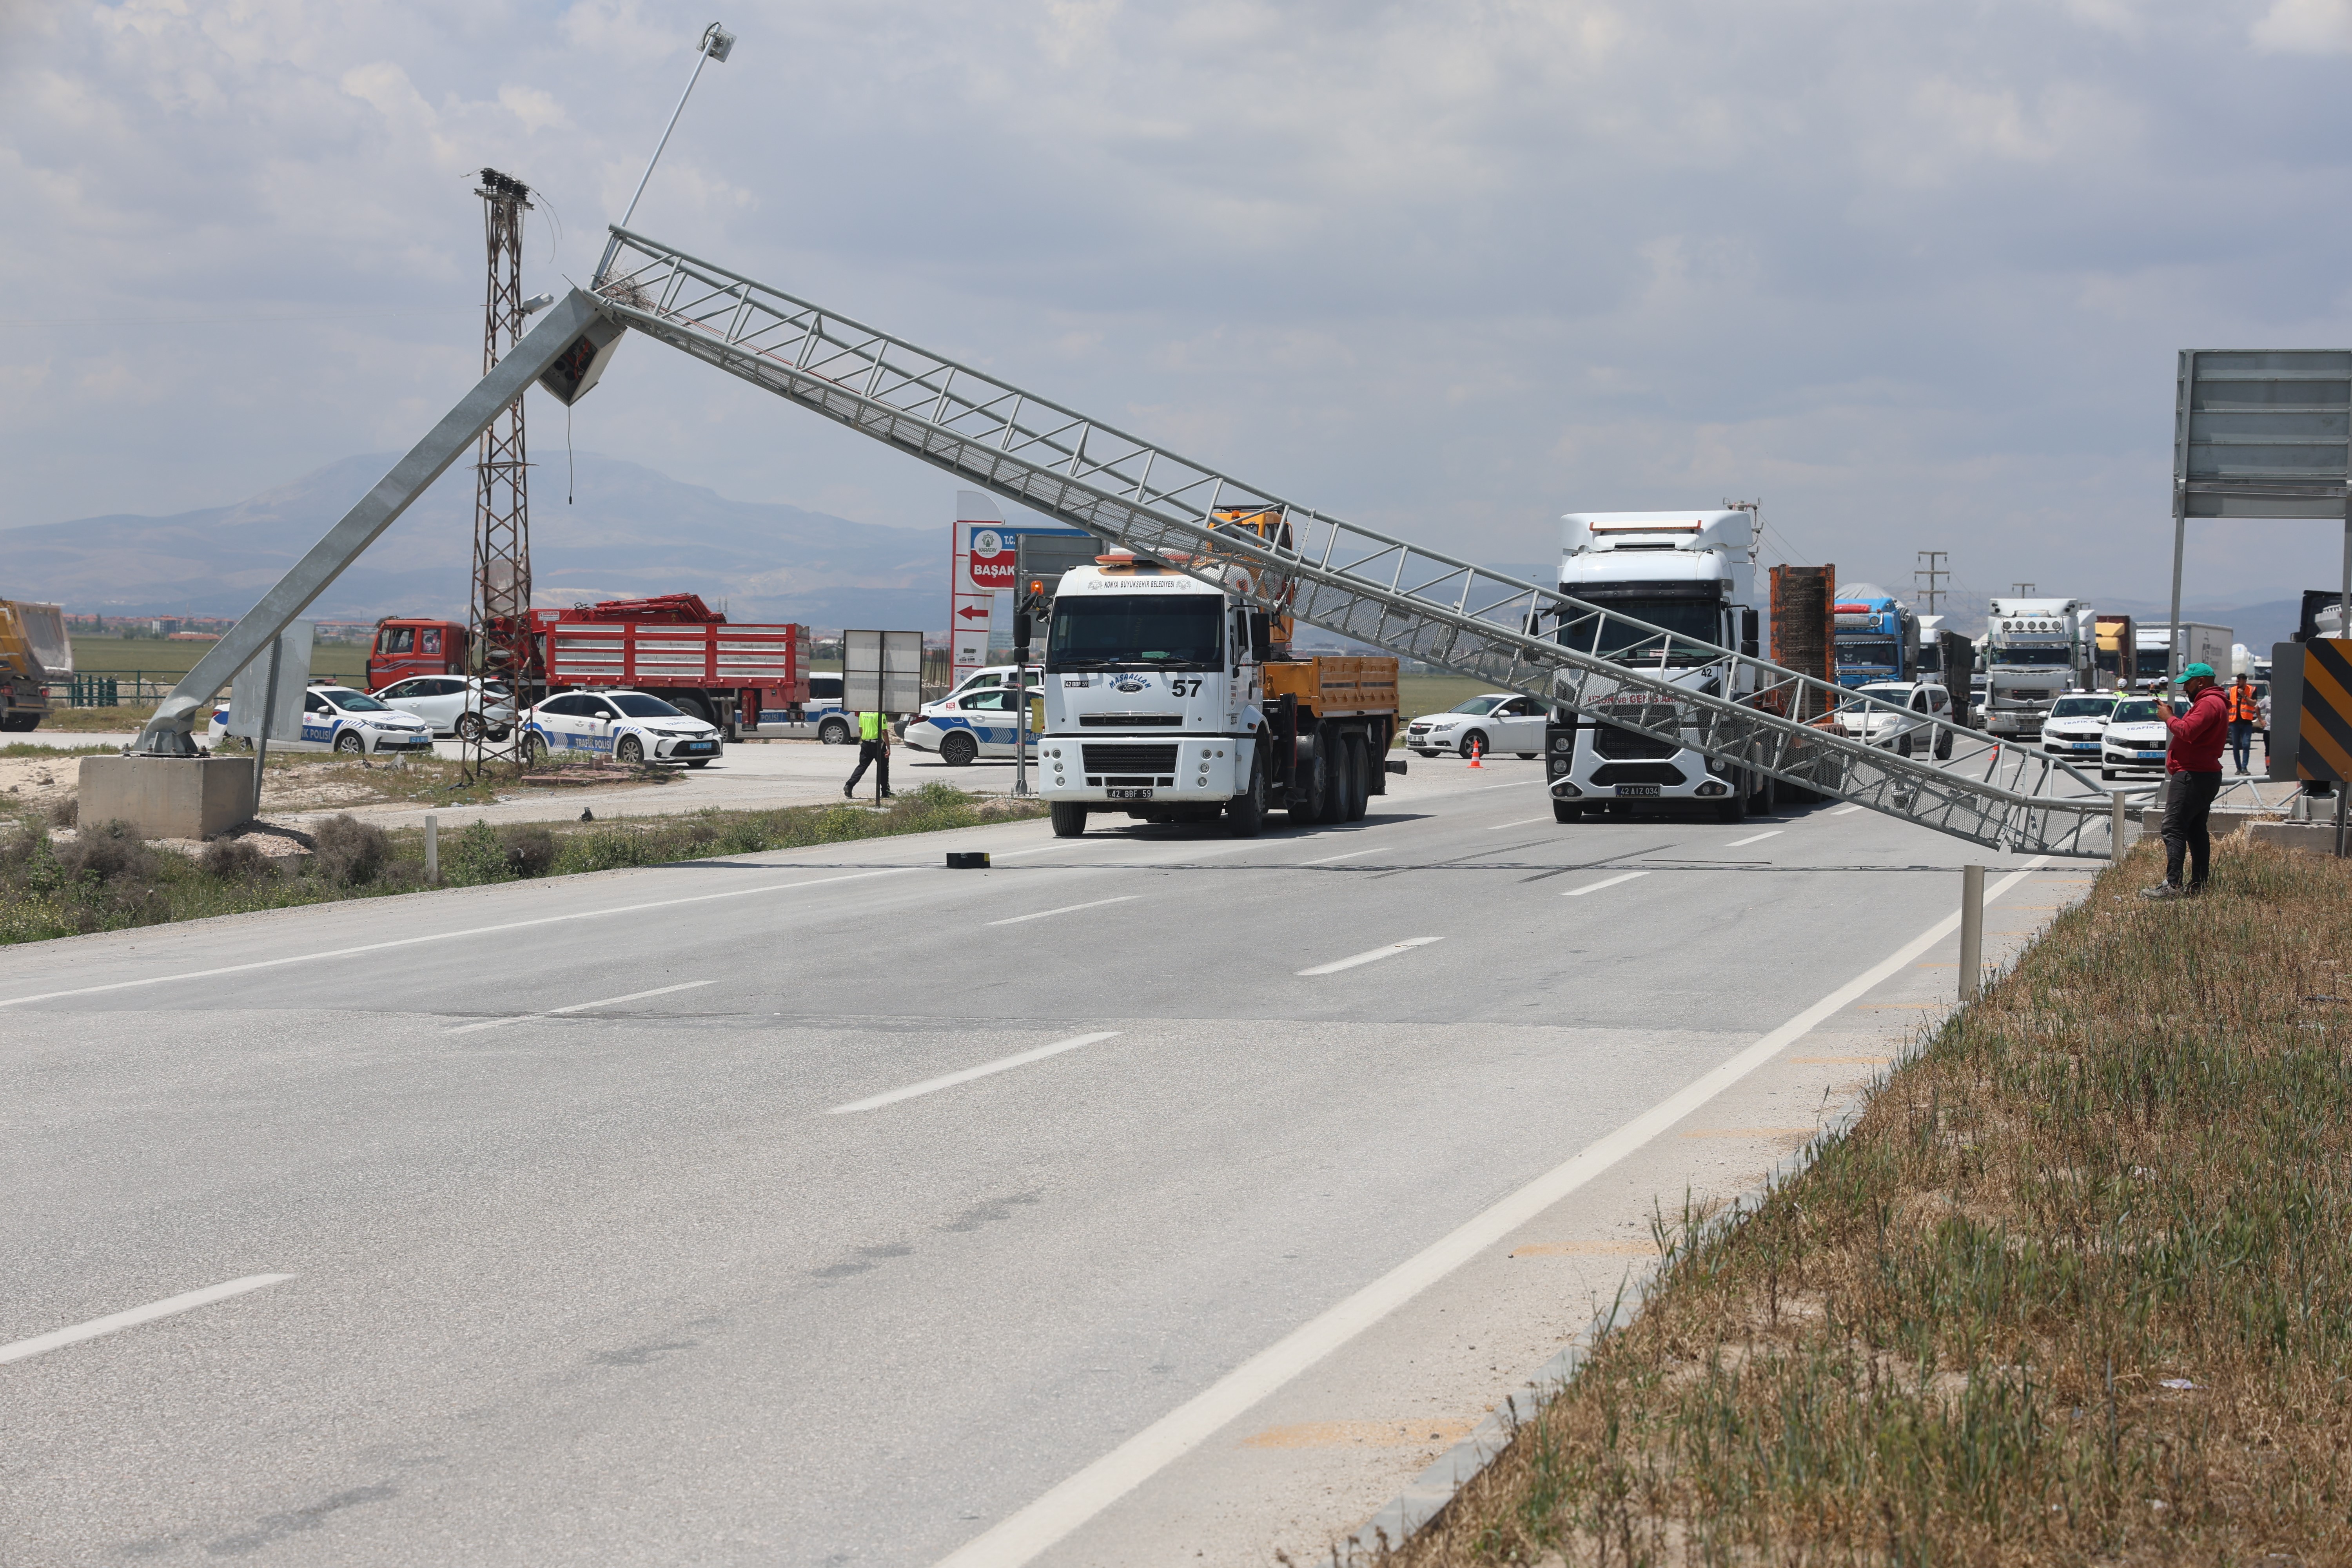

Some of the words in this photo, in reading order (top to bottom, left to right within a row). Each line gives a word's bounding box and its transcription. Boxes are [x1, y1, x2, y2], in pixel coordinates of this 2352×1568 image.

[1004, 536, 1015, 544] T.C.
[1121, 579, 1149, 589] BÜYÜKŞEHİR
[1151, 579, 1174, 588] BELEDİYESİ
[1701, 668, 1712, 677] 42
[1109, 673, 1152, 689] MAŞAALLAH
[1172, 679, 1202, 697] 57
[310, 729, 330, 740] POLİSİ
[595, 739, 612, 750] POLİSİ
